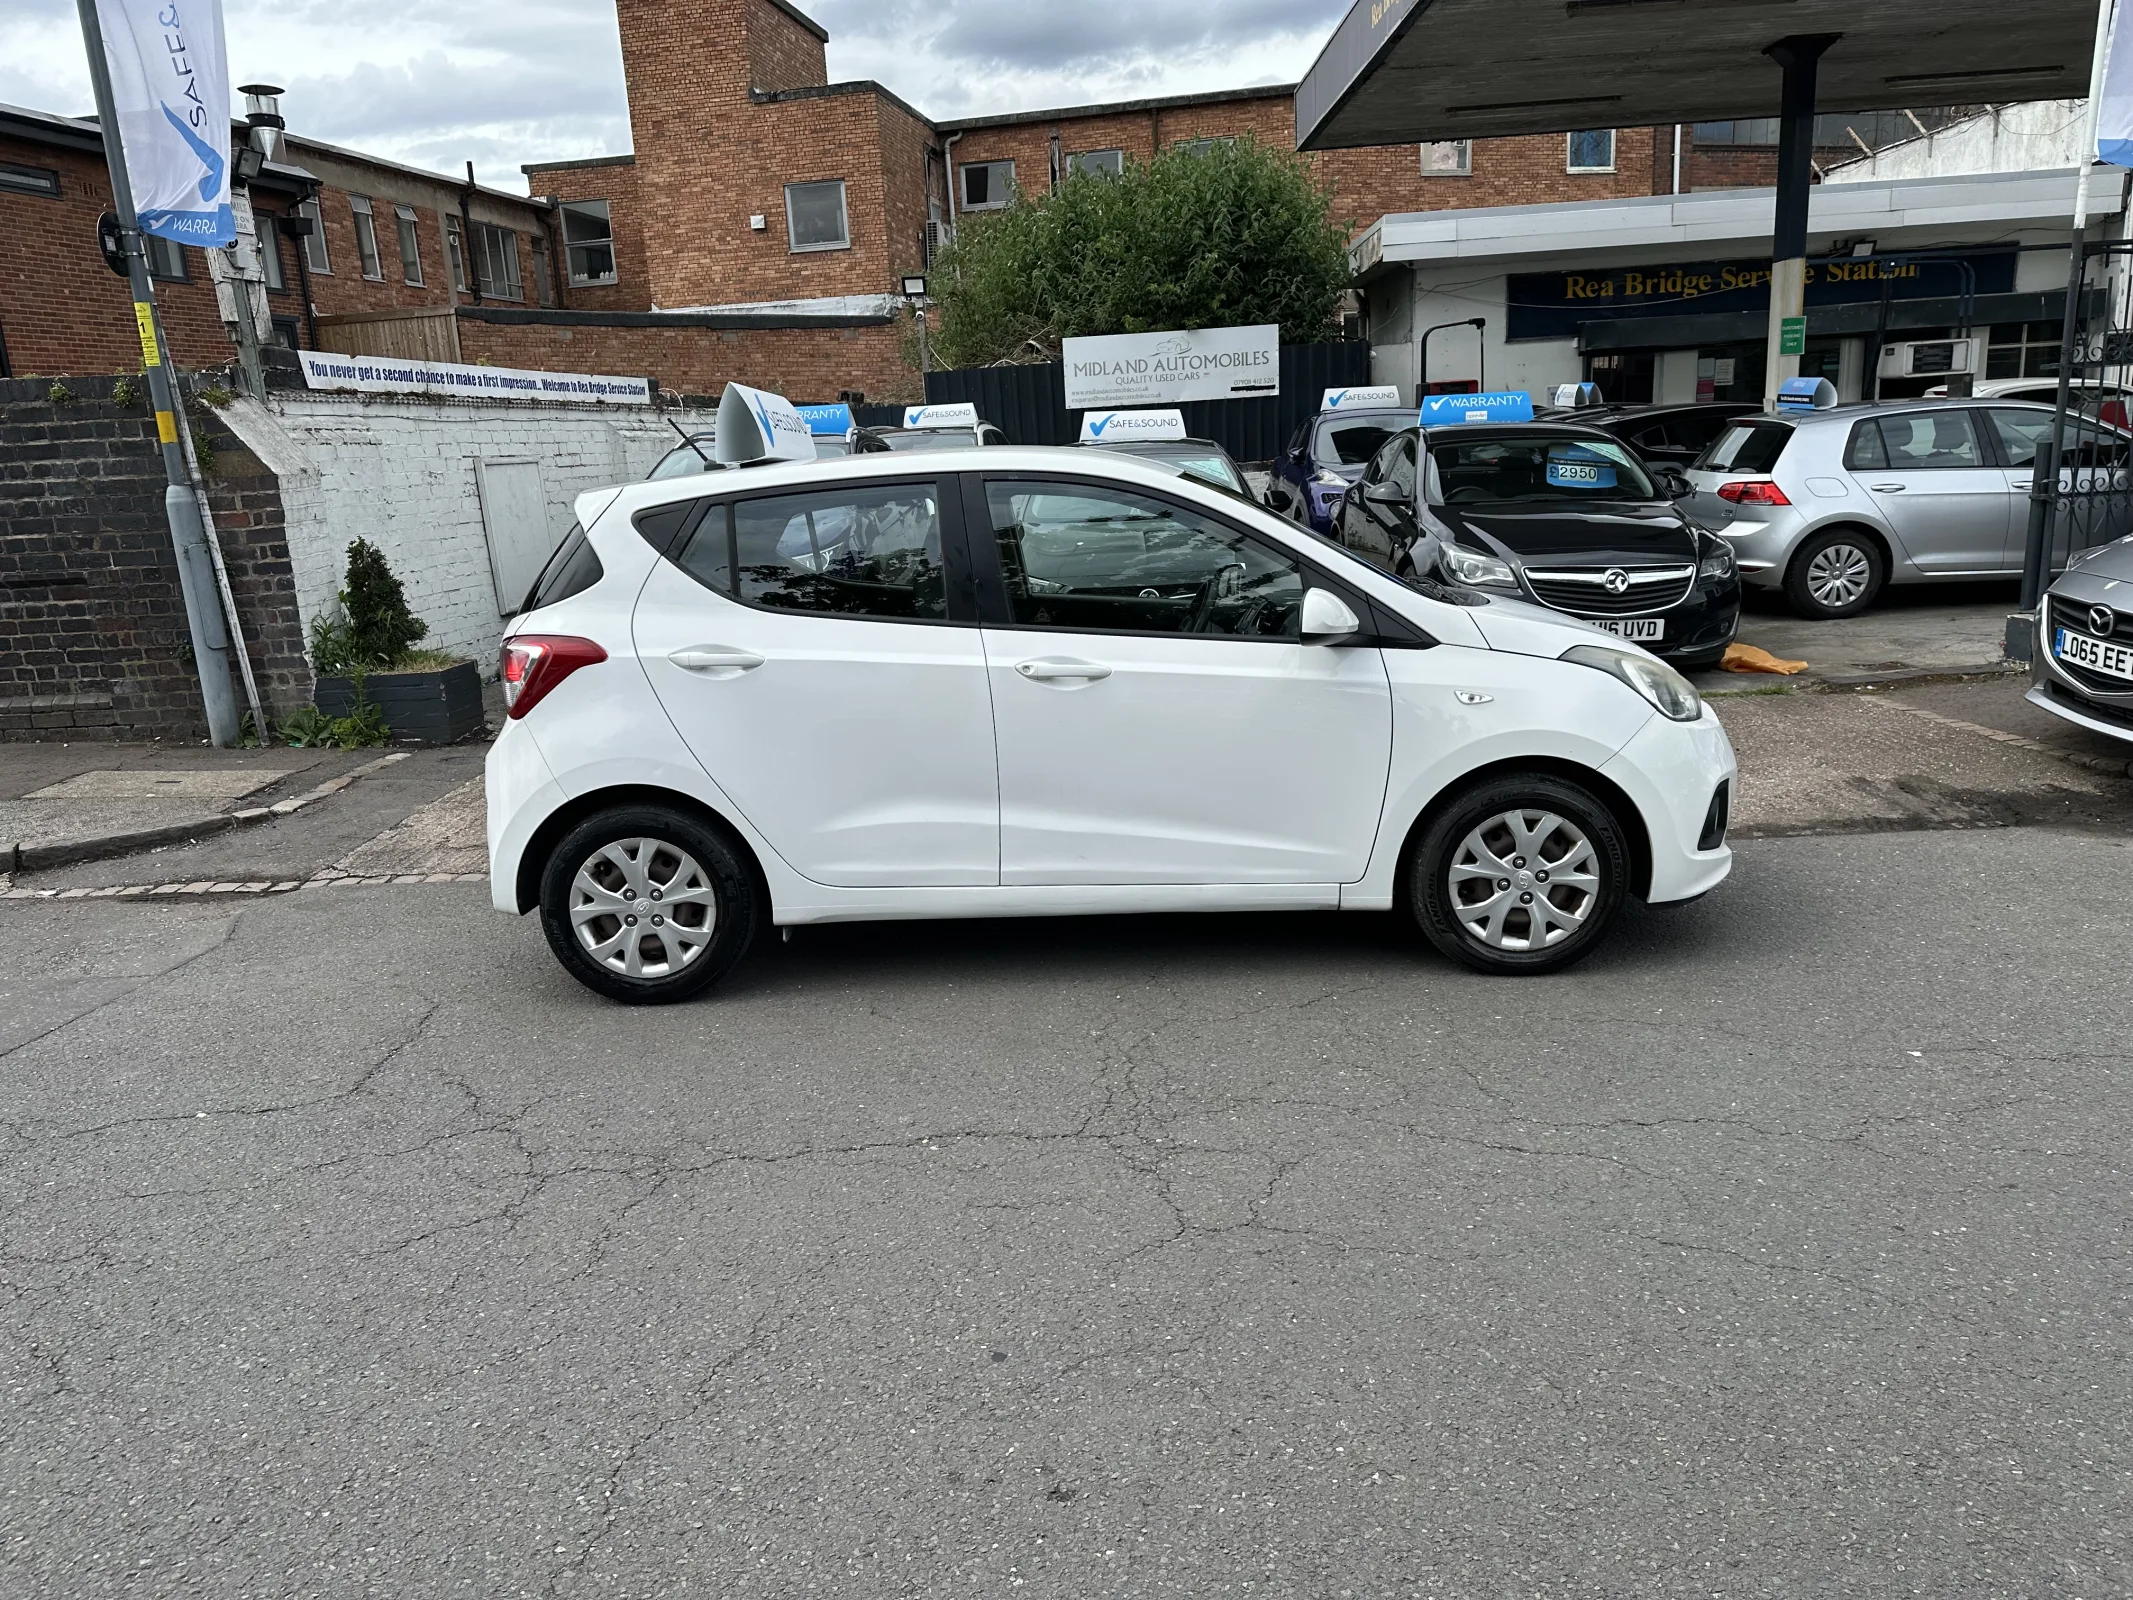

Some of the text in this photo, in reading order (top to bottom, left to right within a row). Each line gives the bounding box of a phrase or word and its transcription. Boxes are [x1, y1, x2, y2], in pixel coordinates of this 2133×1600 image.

[1565, 276, 1614, 299] Rea
[1623, 270, 1712, 298] Bridge
[139, 321, 146, 333] 1
[1074, 351, 1270, 377] MIDLAND AUTOMOBILES
[309, 360, 328, 377] You
[329, 364, 356, 379] never
[358, 366, 374, 381] get
[375, 367, 382, 381] a
[383, 368, 414, 383] second
[415, 369, 445, 384] chance
[446, 371, 454, 385] to
[456, 372, 476, 387] make
[477, 374, 482, 387] a
[483, 373, 499, 388] first
[541, 379, 570, 392] Welcome
[570, 380, 577, 393] to
[577, 381, 588, 393] Rea
[588, 382, 607, 395] Bridge
[608, 383, 627, 395] Service
[628, 383, 645, 396] Station
[1115, 372, 1200, 385] QUALITY USED CARS
[1343, 392, 1395, 401] SAFE&SOUND
[1449, 395, 1524, 408] WARRANTY
[922, 409, 971, 418] SAFE&SOUND
[1109, 418, 1178, 428] SAFE&SOUND
[1624, 621, 1657, 636] UVD
[2103, 646, 2133, 674] EE
